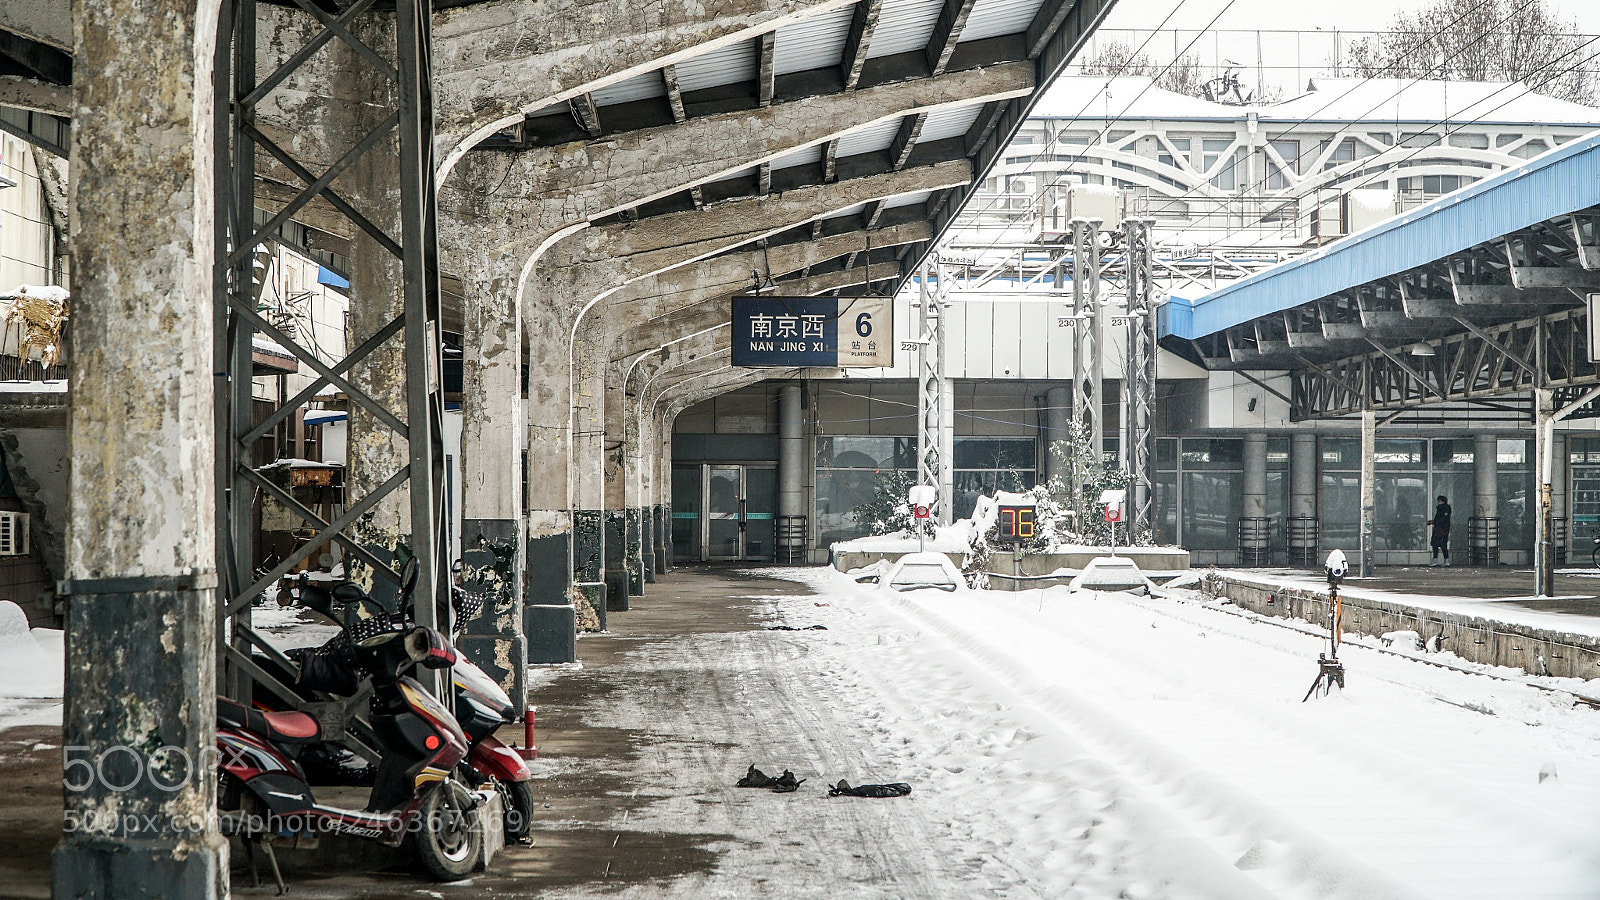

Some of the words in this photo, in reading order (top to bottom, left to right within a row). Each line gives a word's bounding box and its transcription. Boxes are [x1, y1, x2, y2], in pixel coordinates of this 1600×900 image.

[749, 312, 825, 338] 南京西
[855, 312, 872, 338] 6
[1058, 319, 1075, 328] 230
[1111, 318, 1127, 327] 231
[750, 342, 774, 352] NAN
[780, 342, 806, 352] JING
[812, 342, 824, 352] XI
[851, 340, 877, 350] 站台
[900, 343, 917, 352] 229
[1001, 509, 1034, 537] 76
